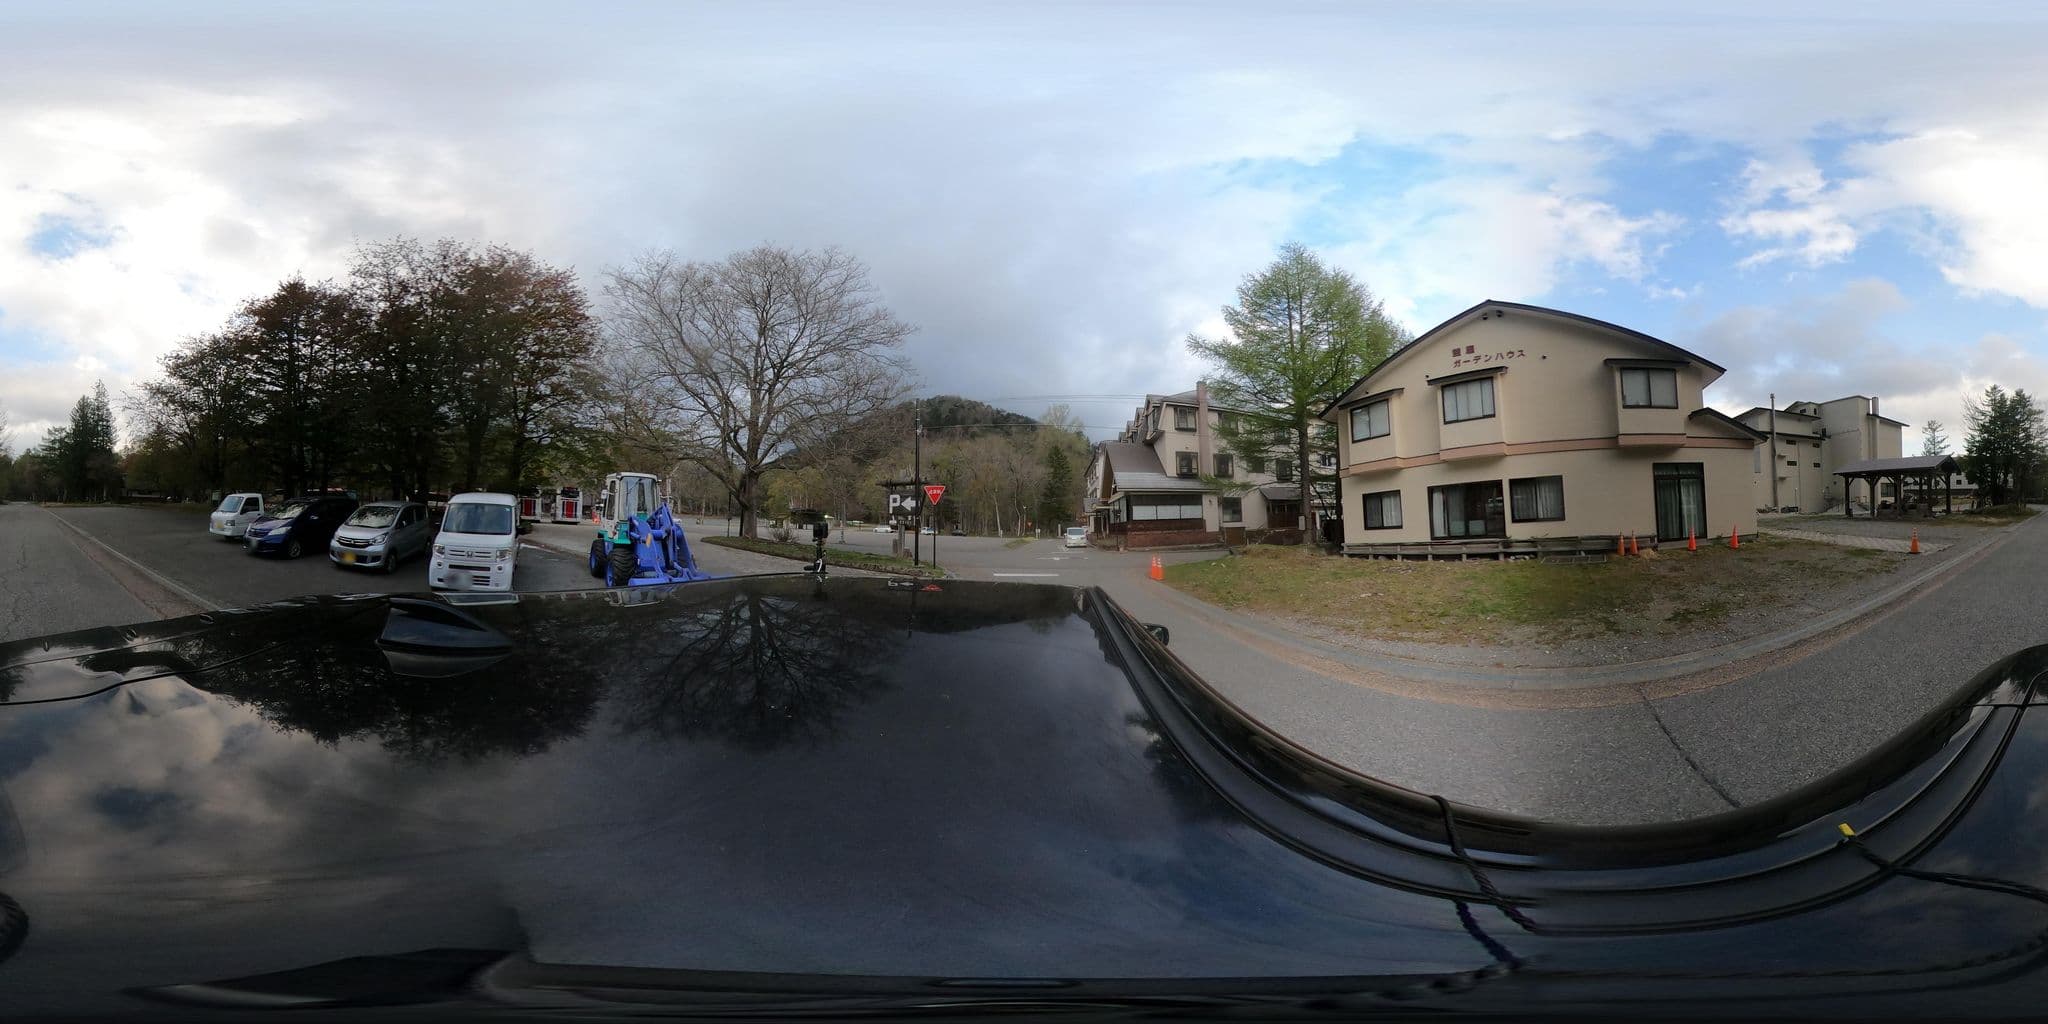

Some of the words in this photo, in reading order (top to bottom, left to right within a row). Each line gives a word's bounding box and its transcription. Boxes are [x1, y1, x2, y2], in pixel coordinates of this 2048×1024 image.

[1453, 349, 1526, 368] ガーデンハウス
[889, 494, 901, 514] P
